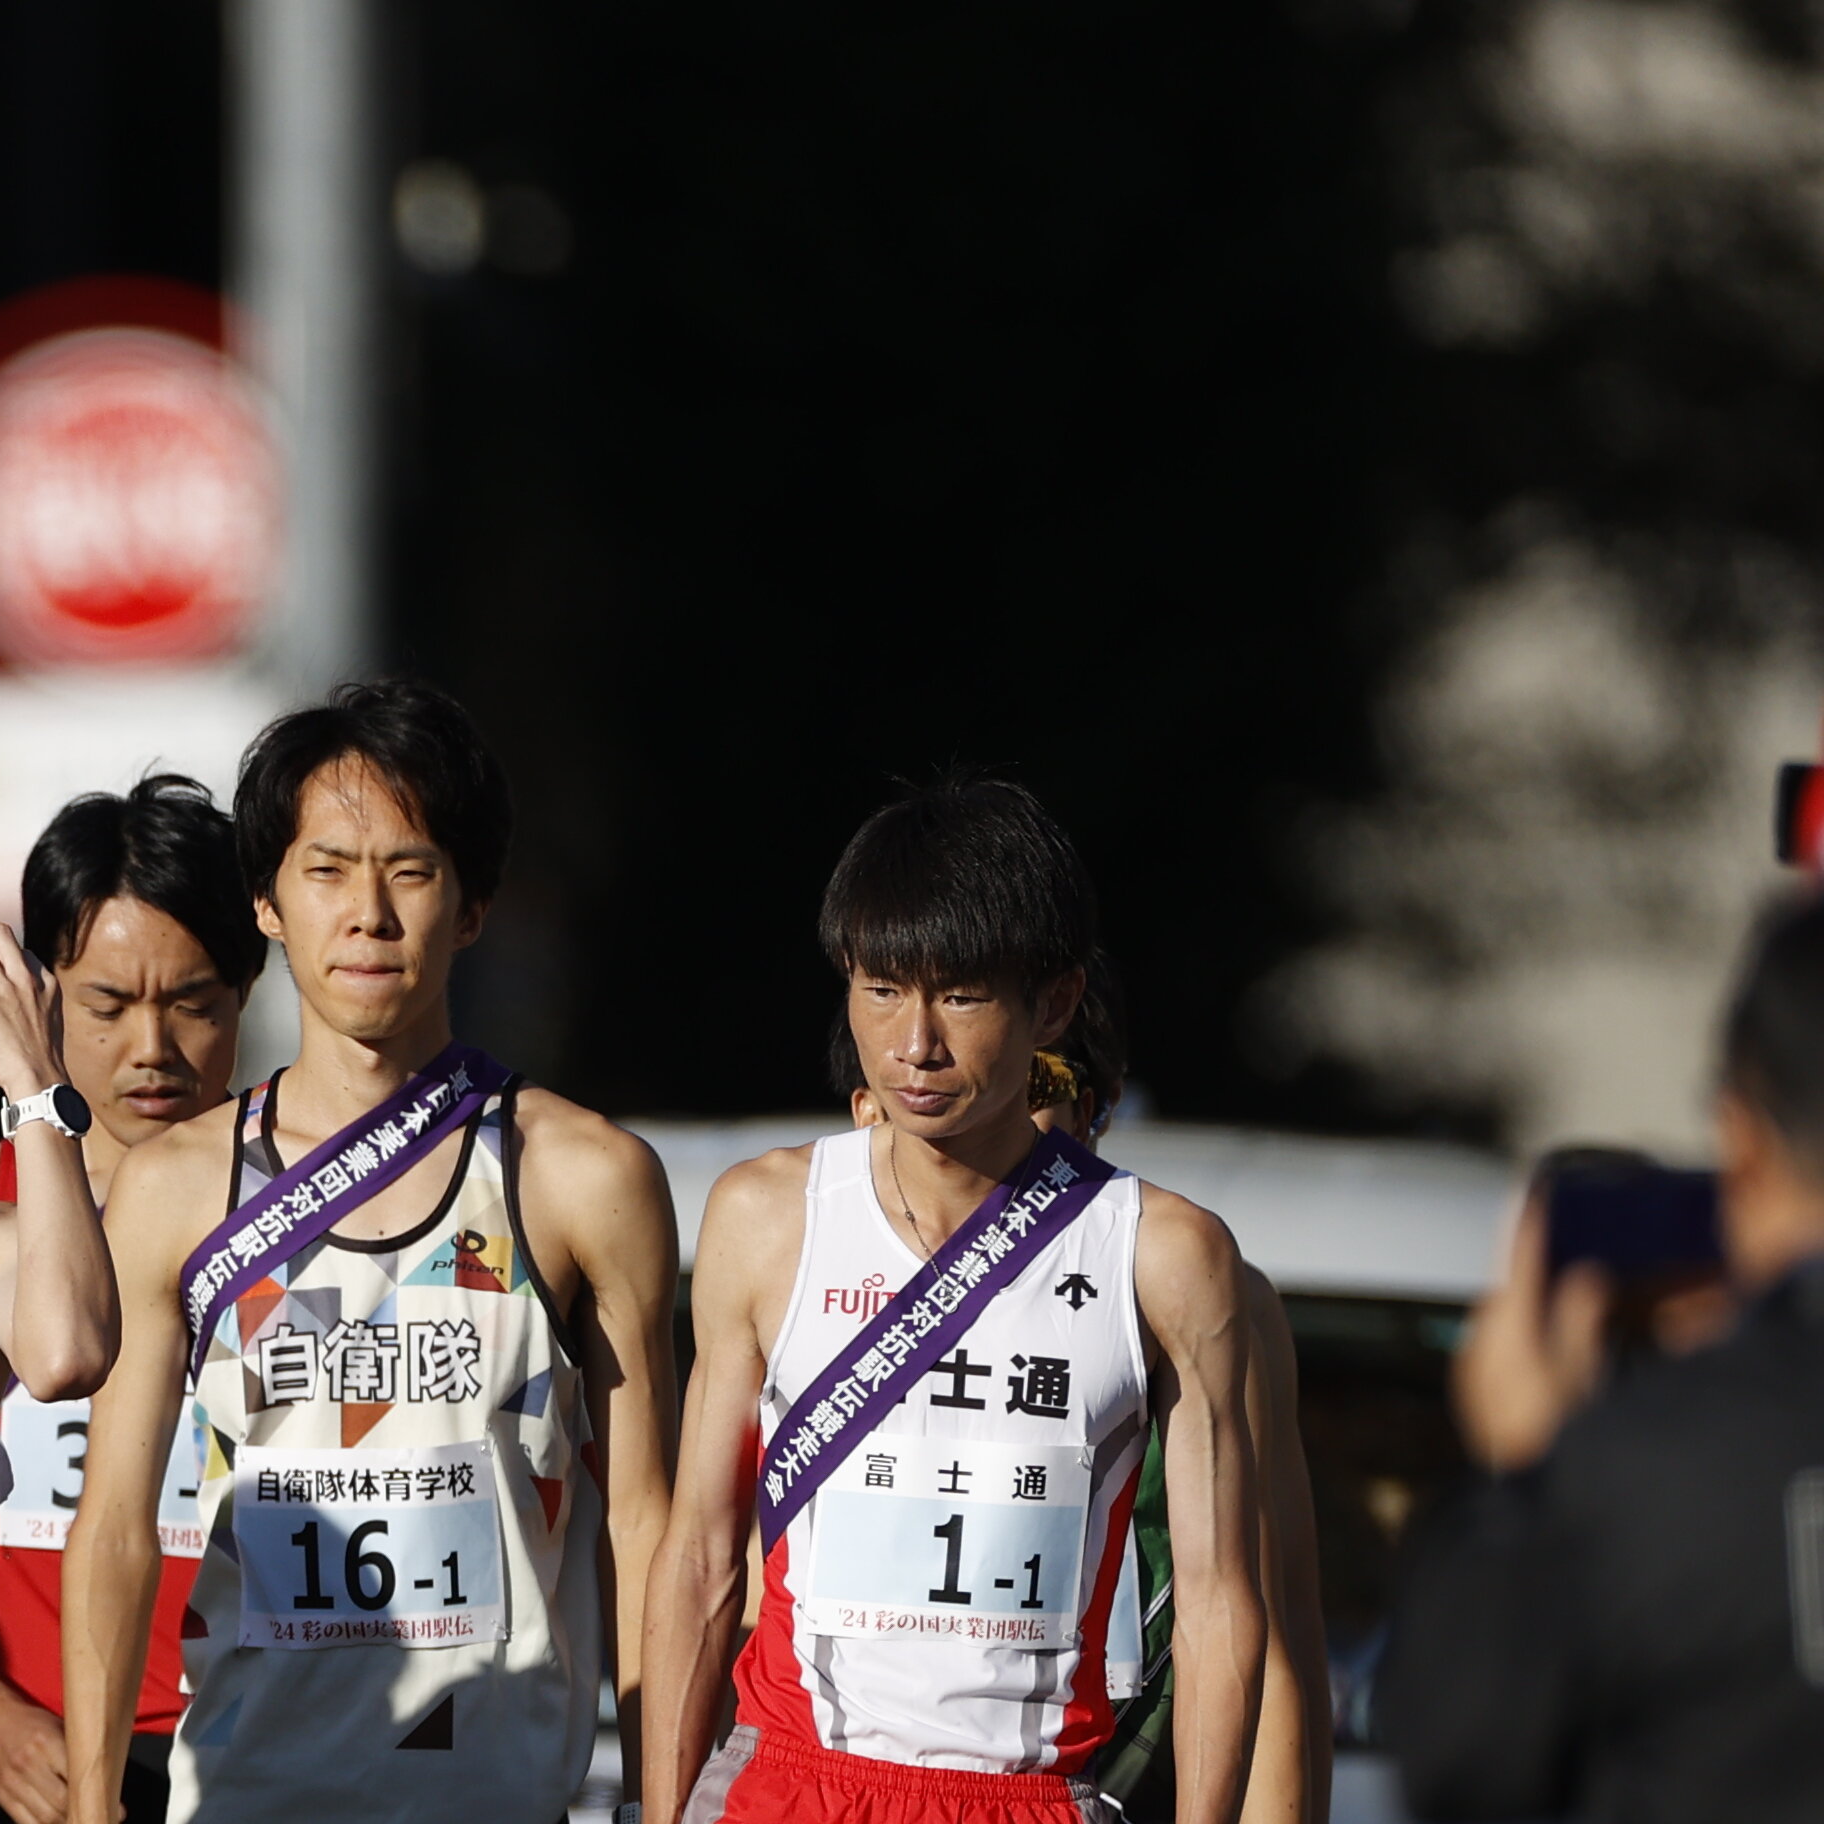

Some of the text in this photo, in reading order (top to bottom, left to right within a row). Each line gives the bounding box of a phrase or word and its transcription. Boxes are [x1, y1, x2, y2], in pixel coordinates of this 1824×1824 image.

[187, 1061, 474, 1372] 東日本実業団対抗駅伝競走
[258, 1319, 482, 1405] 自衛隊
[764, 1153, 1080, 1507] 東日本実業団対抗駅伝競走大会
[898, 1349, 1071, 1420] 士通
[257, 1462, 476, 1503] 自衛隊体育学校
[291, 1519, 468, 1612] 16-1
[929, 1514, 1044, 1610] 1-1
[303, 1614, 474, 1642] 彩の国実業団駅伝
[839, 1608, 1046, 1641] '24 彩の国実業団駅伝
